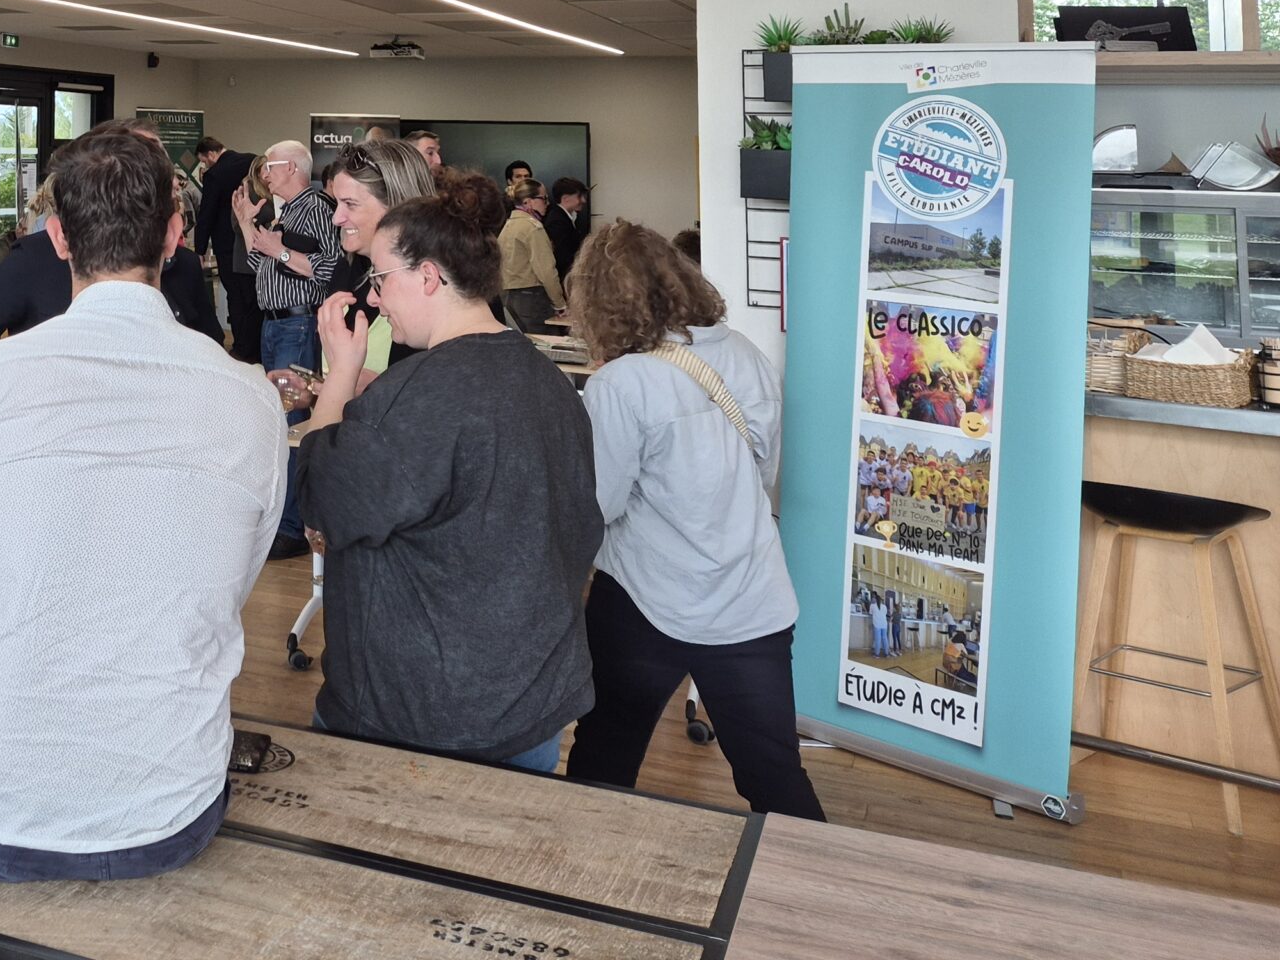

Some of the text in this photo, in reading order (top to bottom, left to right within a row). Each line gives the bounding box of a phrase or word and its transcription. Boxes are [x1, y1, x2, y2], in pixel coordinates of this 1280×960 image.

[937, 59, 988, 74] Charleville
[147, 113, 197, 125] Agronutris
[313, 132, 353, 144] actua
[898, 155, 969, 187] CAROLO
[887, 171, 907, 198] VILLE
[883, 236, 918, 249] CAMPUS
[868, 308, 983, 339] Le CLASSICO
[899, 522, 923, 538] Que
[926, 527, 947, 543] Des
[928, 542, 945, 558] MA
[913, 682, 924, 715] À
